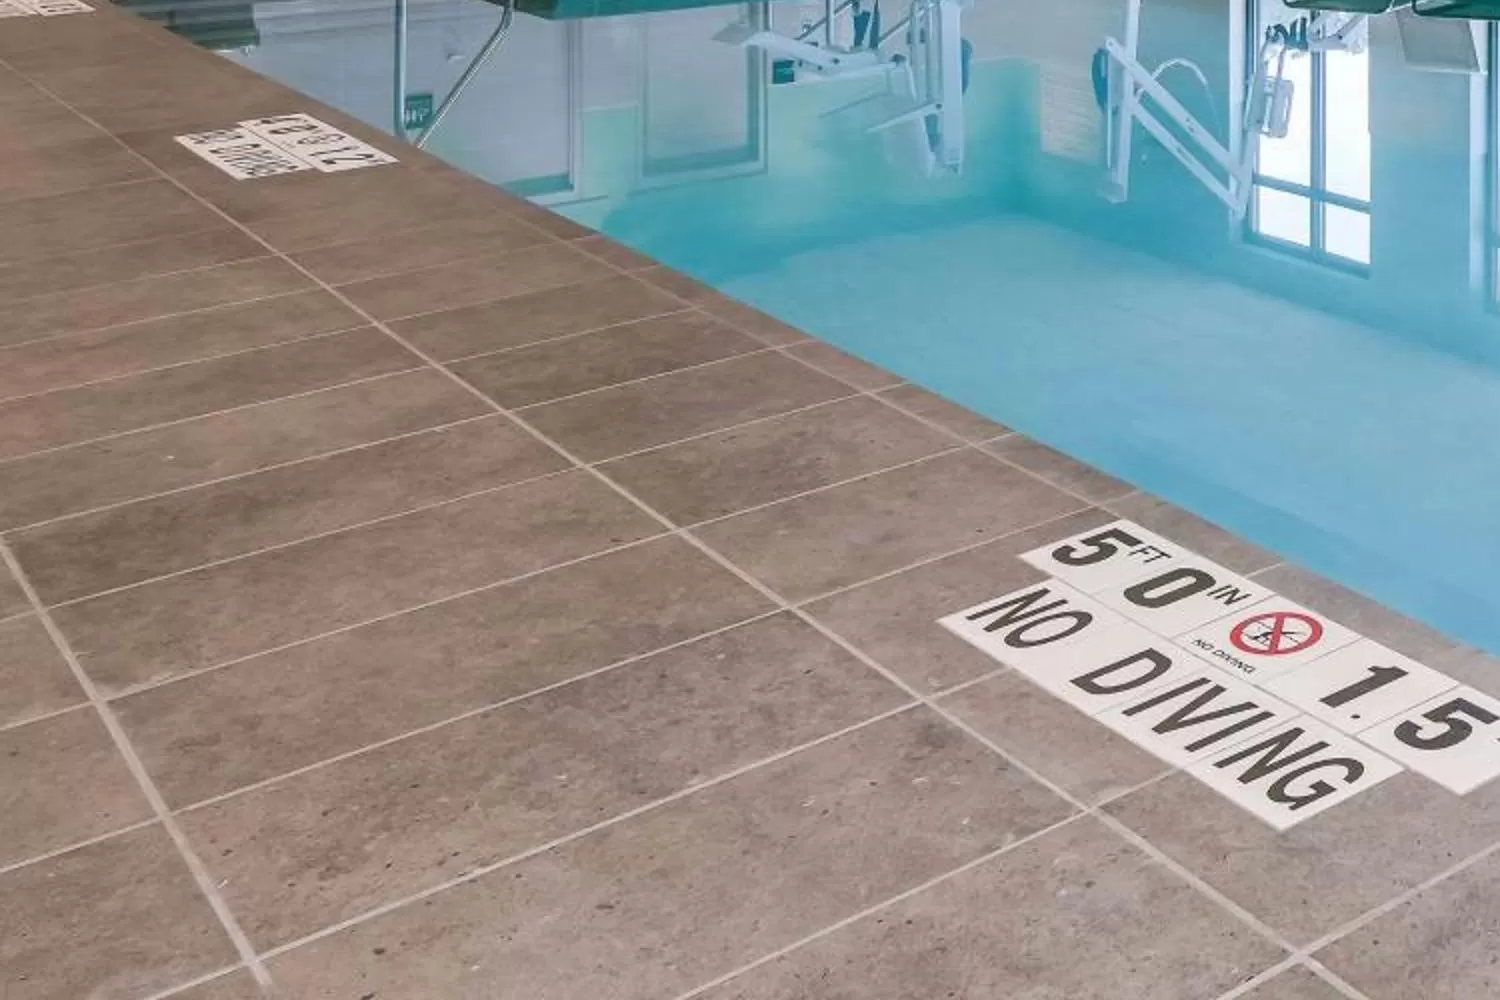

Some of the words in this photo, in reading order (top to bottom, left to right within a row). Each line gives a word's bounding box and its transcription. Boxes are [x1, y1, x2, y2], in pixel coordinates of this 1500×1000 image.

[1051, 528, 1143, 567] 5
[1130, 543, 1172, 563] FT
[1123, 567, 1217, 608] 0
[1207, 583, 1251, 606] IN
[1190, 639, 1214, 651] NO
[1212, 650, 1256, 673] DIVING
[966, 587, 1094, 649] NO
[1070, 648, 1367, 811] DIVING
